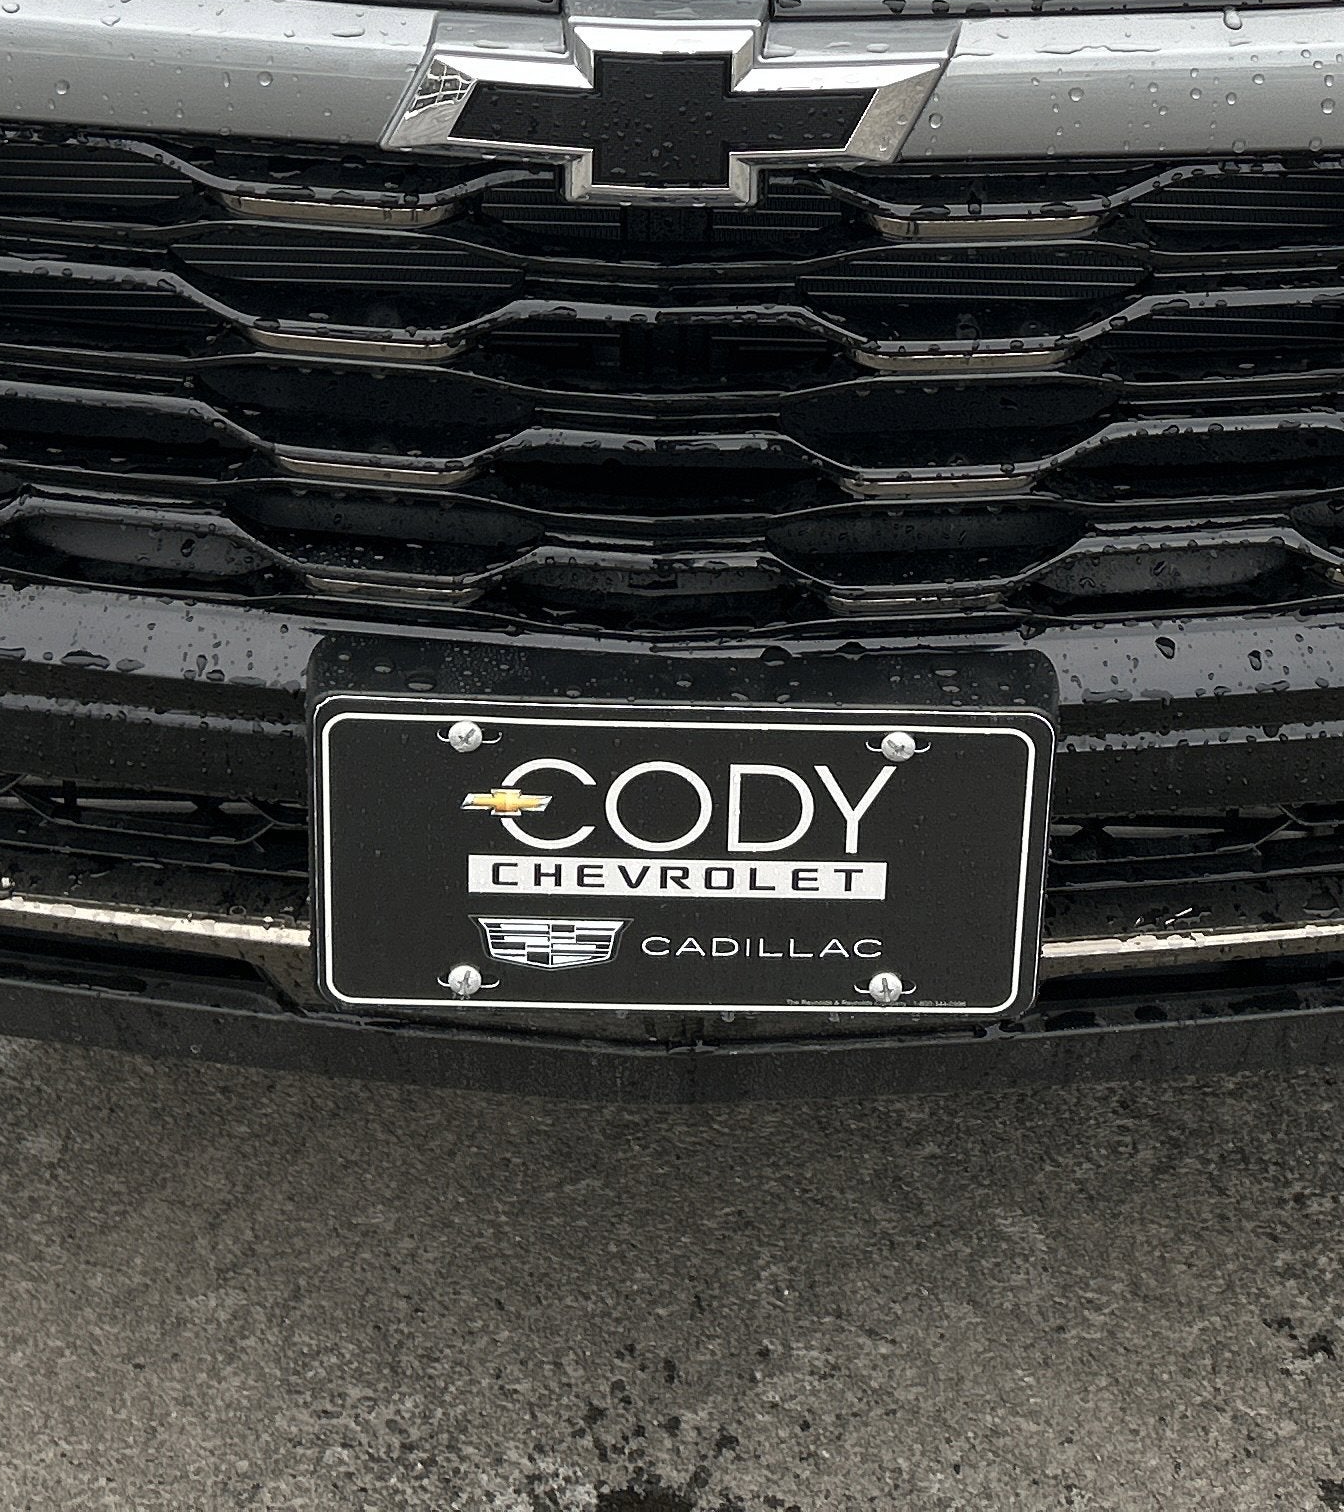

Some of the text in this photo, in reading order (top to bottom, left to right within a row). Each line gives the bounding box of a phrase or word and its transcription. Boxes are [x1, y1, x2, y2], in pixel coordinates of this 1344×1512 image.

[498, 758, 897, 854] CODY
[491, 862, 864, 892] CHEVROLET
[641, 936, 883, 959] CADILLAC
